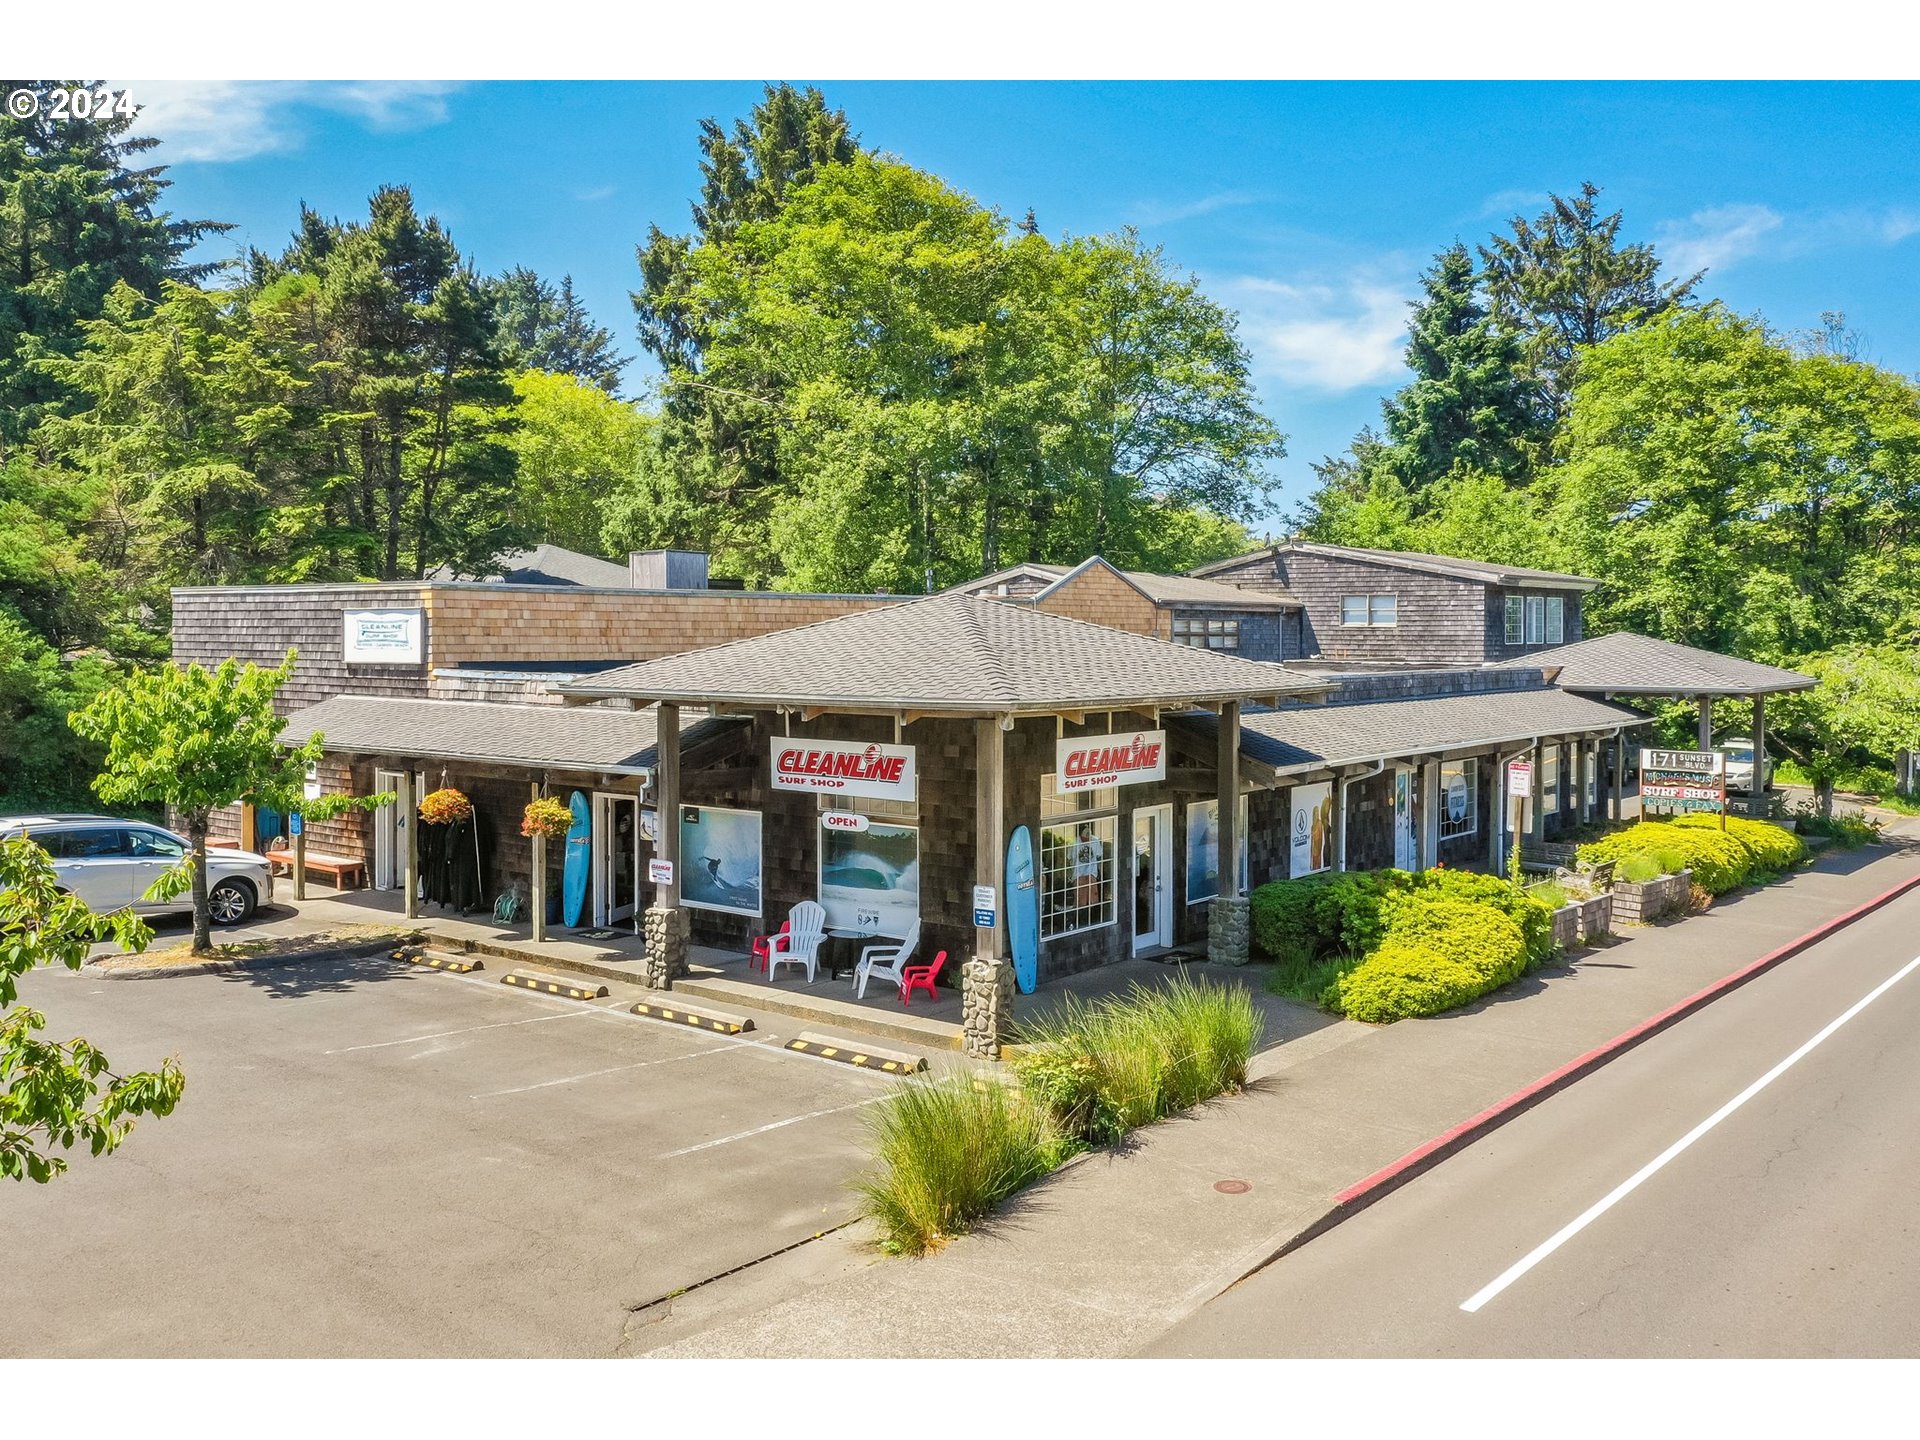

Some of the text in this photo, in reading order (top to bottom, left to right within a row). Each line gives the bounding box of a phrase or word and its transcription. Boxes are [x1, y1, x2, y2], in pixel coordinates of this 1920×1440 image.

[1064, 735, 1161, 778] CLEANLINE
[1652, 752, 1712, 767] 171 SUNSET
[777, 745, 907, 783] CLEANLINE
[1685, 761, 1706, 769] BLVD.
[778, 776, 845, 788] SURF SHOP
[1064, 775, 1118, 789] SURF SHOP
[1692, 774, 1719, 787] MUSIC
[1643, 786, 1719, 800] SURF SHOP
[1647, 798, 1683, 807] COPIES
[1695, 802, 1716, 810] FAX
[828, 816, 858, 827] OPEN
